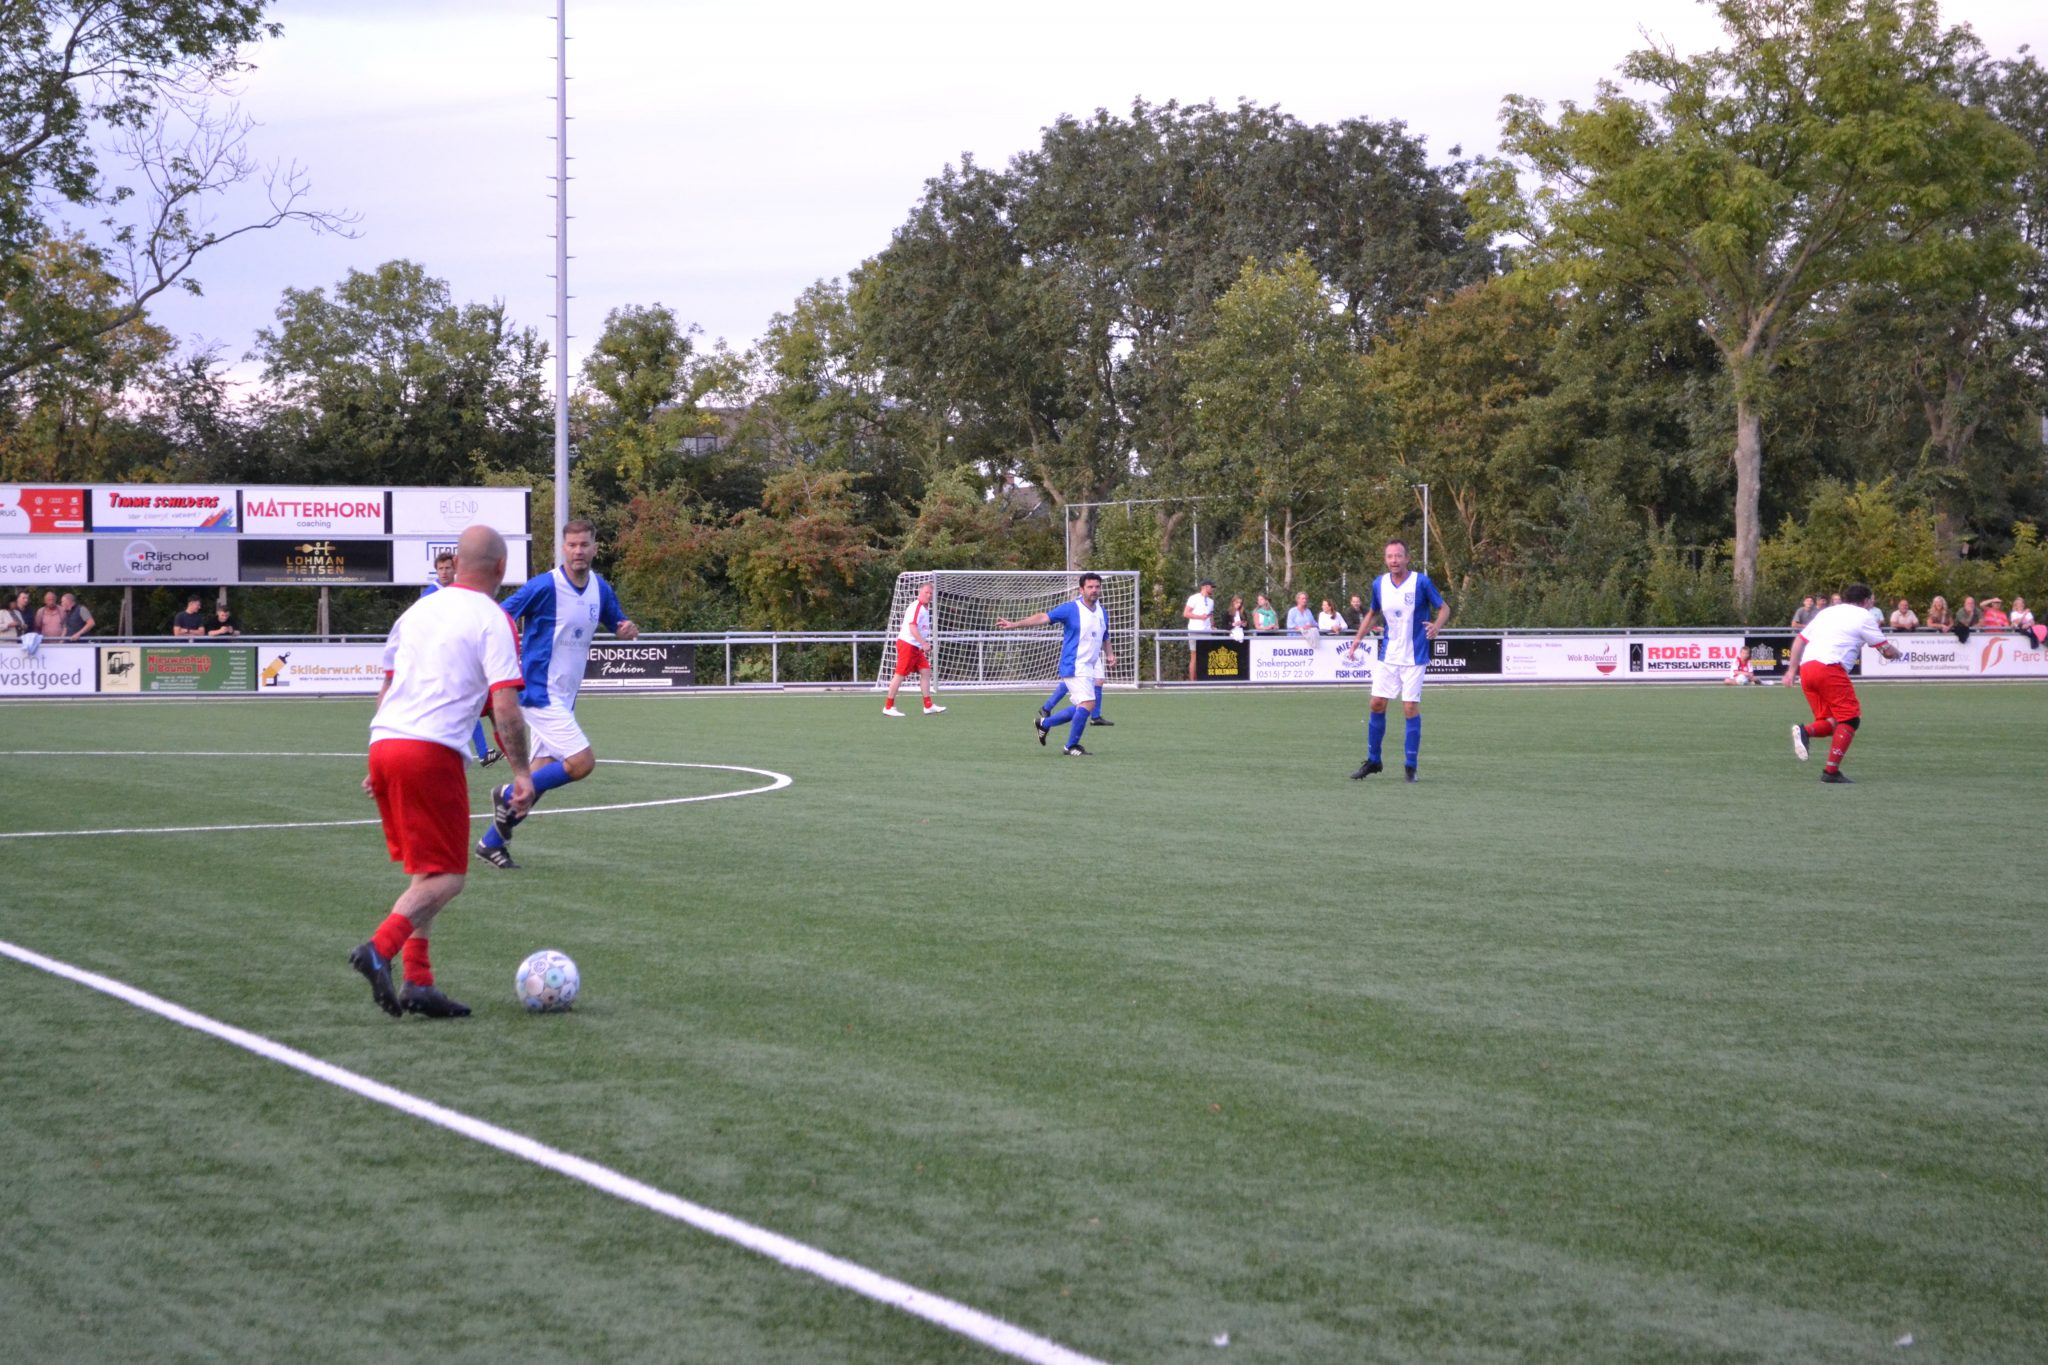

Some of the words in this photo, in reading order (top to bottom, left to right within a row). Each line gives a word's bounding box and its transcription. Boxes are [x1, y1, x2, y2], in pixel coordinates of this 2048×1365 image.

[246, 497, 381, 518] MATTERHORN
[440, 501, 479, 514] BLEND
[296, 520, 331, 529] coaching
[145, 551, 209, 563] Rijschool
[286, 556, 345, 565] LOHMAN
[10, 565, 30, 574] van
[33, 563, 52, 574] der
[54, 563, 83, 574] Werf
[131, 561, 172, 571] Richard
[286, 566, 345, 575] FIETSEN
[1273, 648, 1315, 657] BOLSWARD
[1567, 654, 1584, 662] Wok
[1584, 653, 1618, 662] Bolsward
[1910, 651, 1956, 662] Bolsward
[2013, 650, 2041, 662] Parc
[0, 653, 47, 670] komt
[1256, 658, 1306, 669] Snekerpoort
[1307, 659, 1315, 667] 7
[289, 665, 362, 675] Skilderwurk
[601, 661, 646, 676] Fashion
[0, 668, 81, 690] vastgoed
[1256, 670, 1280, 679] (0515)
[1282, 670, 1292, 678] 57
[1293, 670, 1304, 678] 22
[1305, 670, 1315, 678] 09
